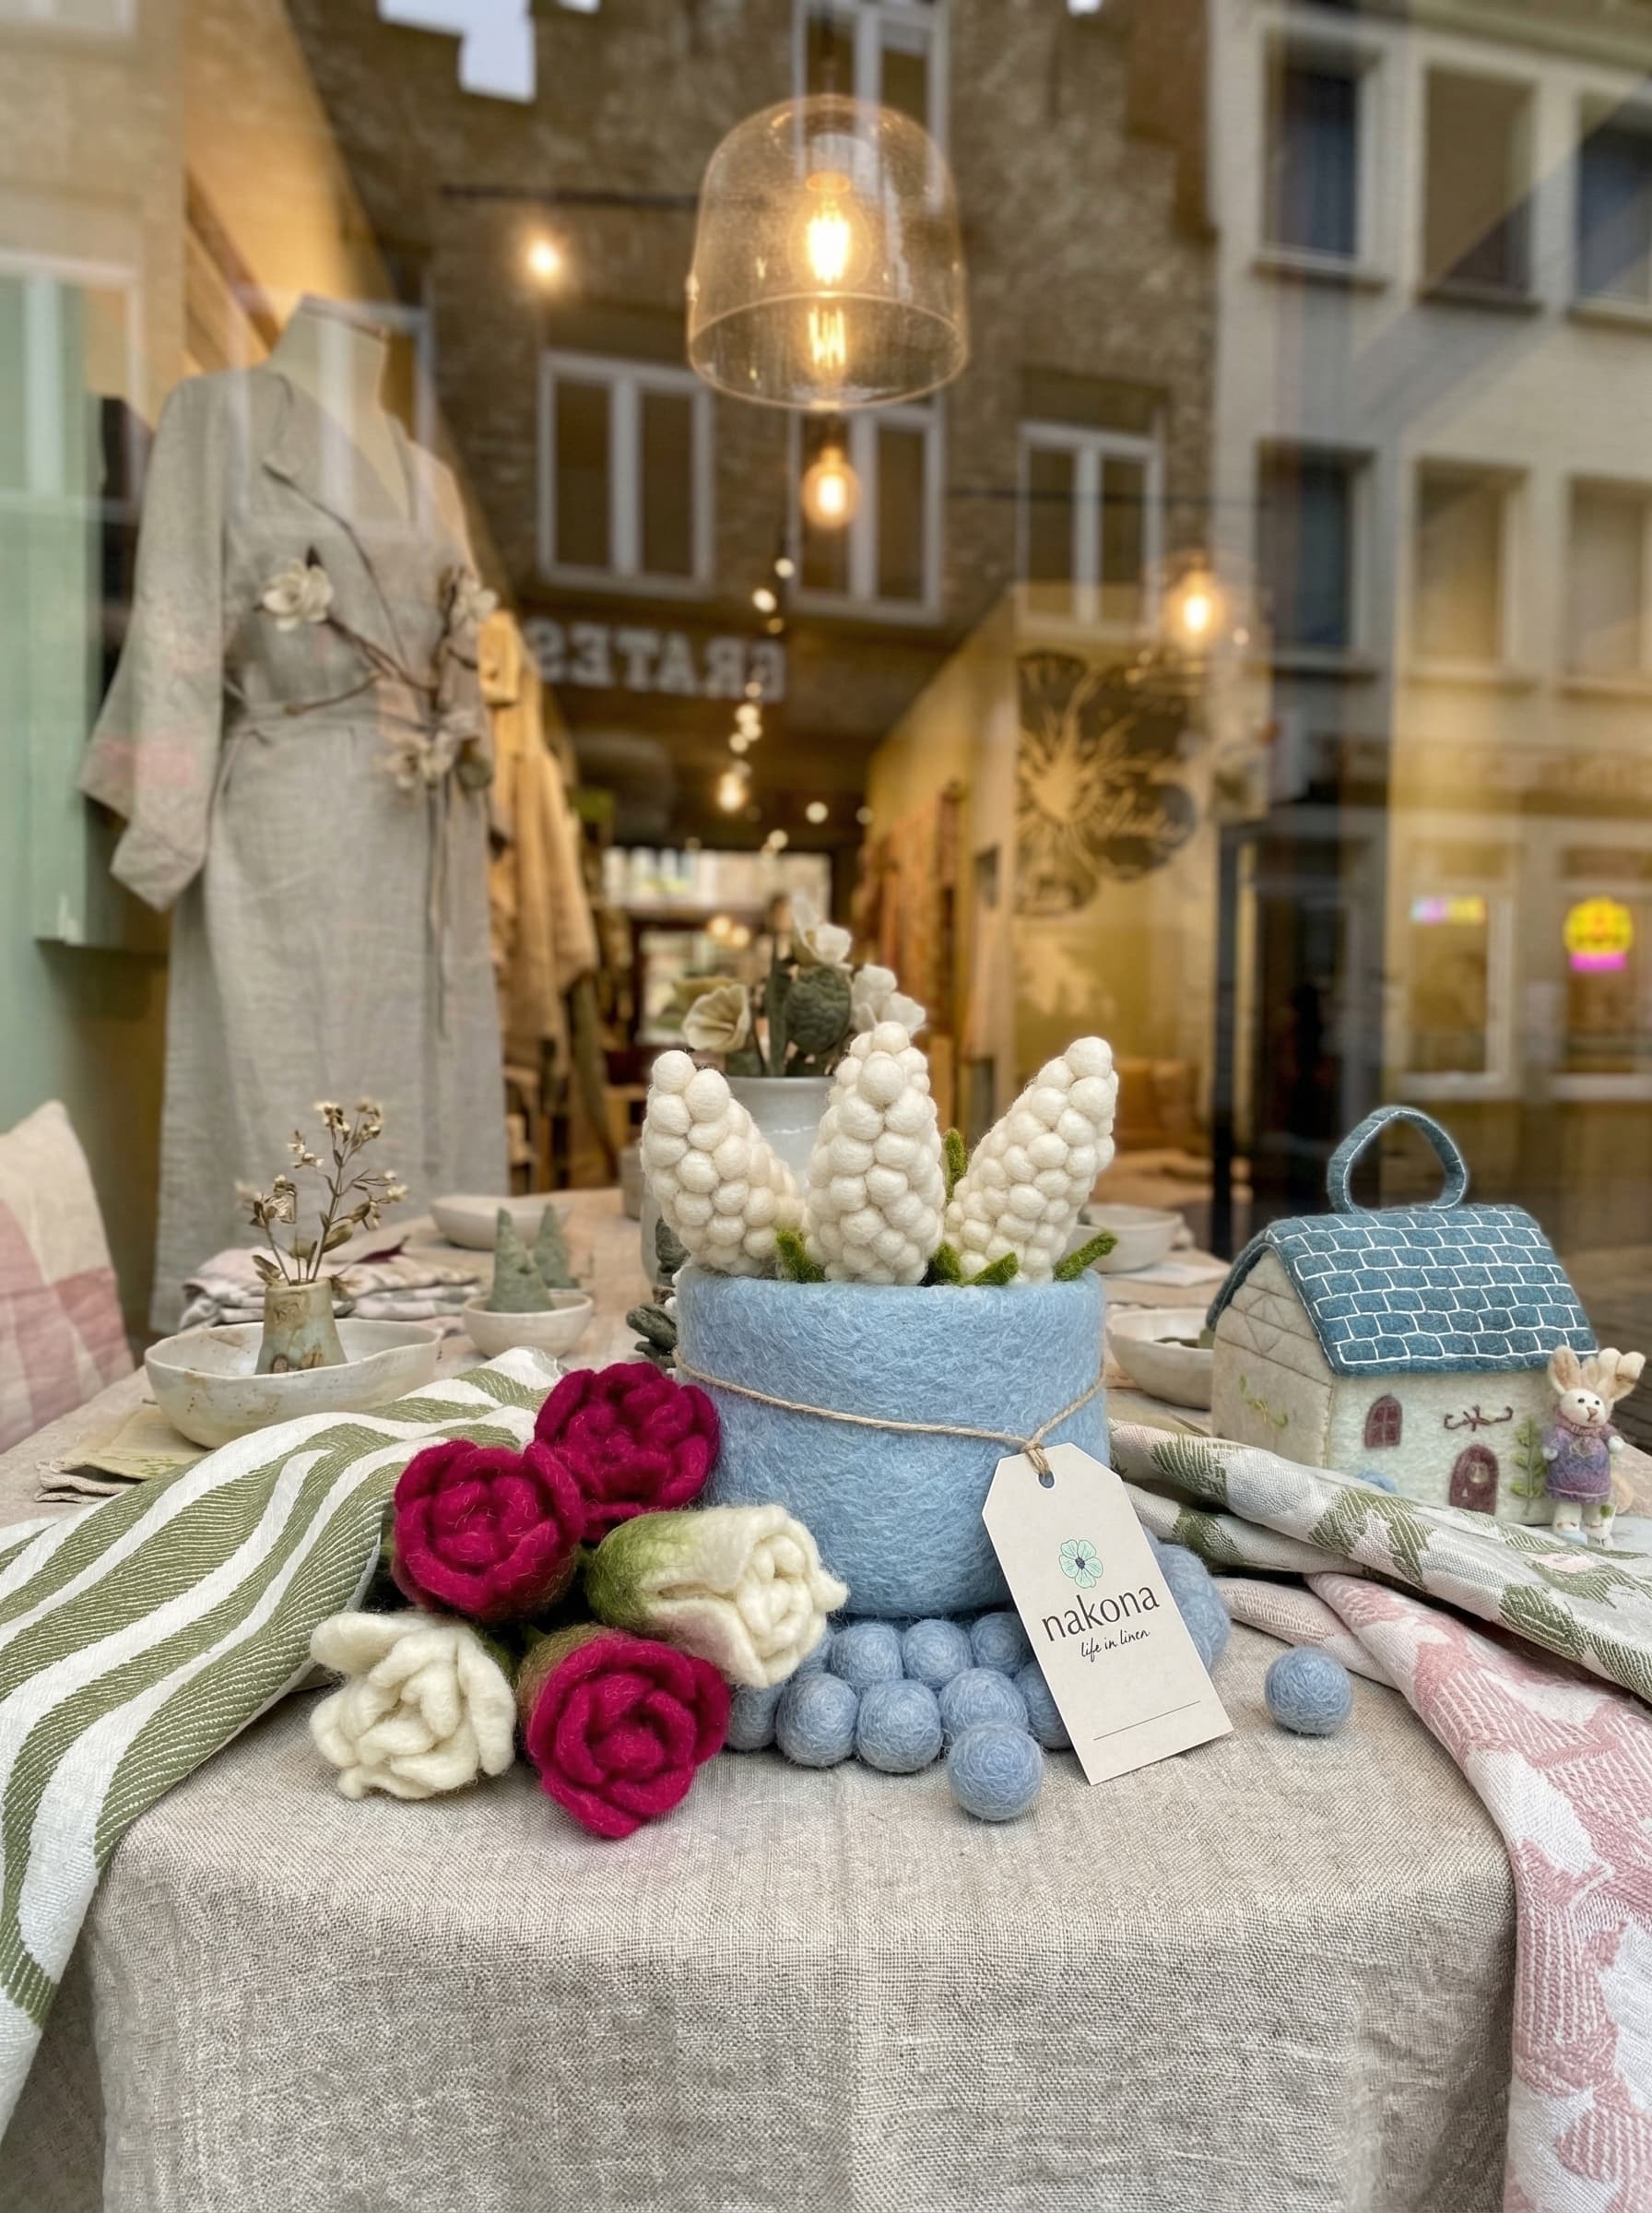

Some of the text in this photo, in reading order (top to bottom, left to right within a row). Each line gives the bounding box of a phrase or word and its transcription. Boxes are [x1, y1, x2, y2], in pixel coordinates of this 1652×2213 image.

[1043, 1587, 1160, 1641] nakona
[1081, 1629, 1150, 1662] life in linen
